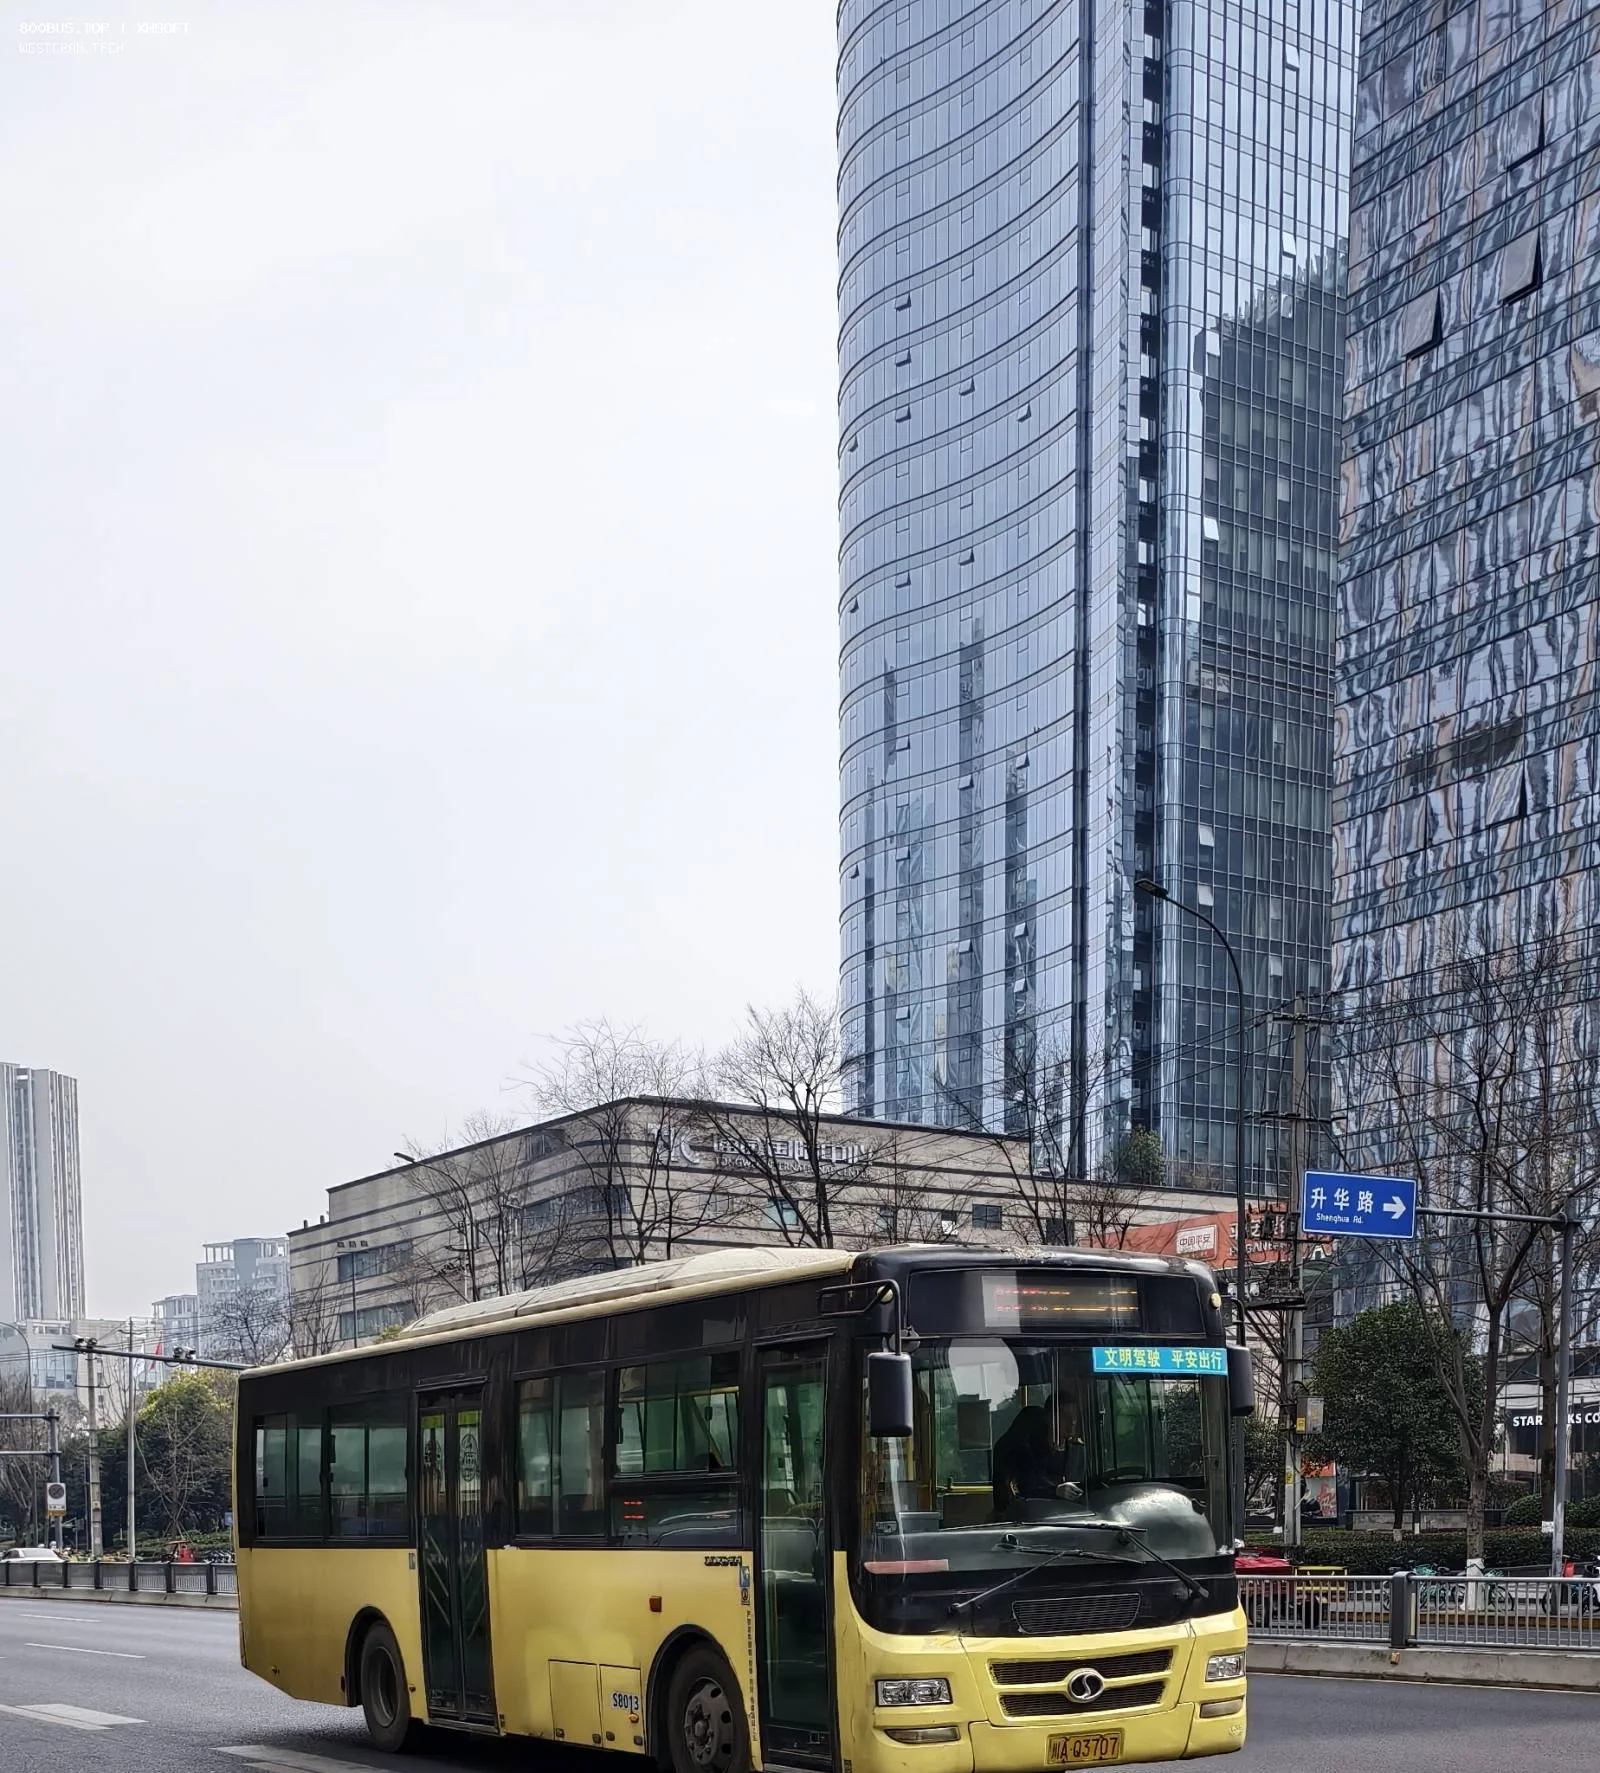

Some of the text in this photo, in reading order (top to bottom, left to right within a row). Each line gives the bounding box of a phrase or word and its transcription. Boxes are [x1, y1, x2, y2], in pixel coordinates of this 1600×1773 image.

[1311, 1186, 1374, 1214] 升华路
[1316, 1212, 1350, 1225] Shenghua
[1104, 1347, 1222, 1370] 文明驾驶 平安出行
[1512, 1413, 1582, 1427] STARKS
[612, 1692, 639, 1711] S8013
